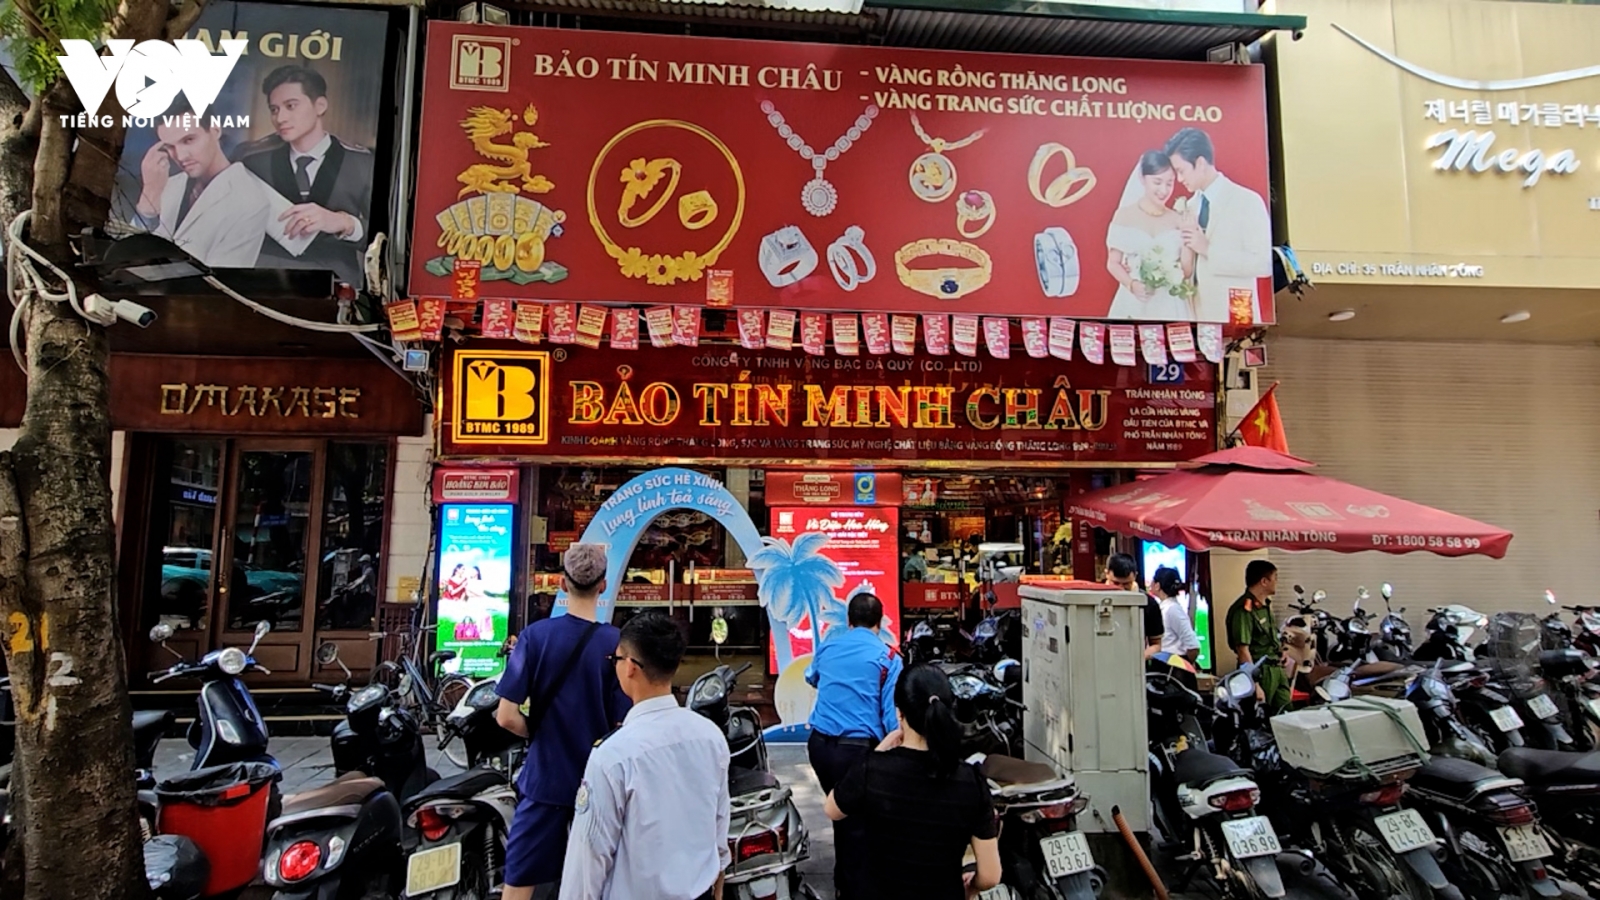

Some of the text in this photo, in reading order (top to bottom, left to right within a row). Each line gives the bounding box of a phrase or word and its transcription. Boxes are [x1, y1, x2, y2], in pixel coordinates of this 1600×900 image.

[259, 29, 343, 60] GIỚI
[534, 50, 843, 92] BẢO TÍN MINH CHÂU
[875, 63, 932, 86] VÀNG
[937, 64, 995, 88] RỒNG
[1000, 68, 1068, 93] THĂNG
[1072, 75, 1126, 95] LONG
[875, 89, 931, 111] VÀNG
[937, 95, 1003, 114] TRANG
[1007, 95, 1047, 116] SỨC
[1051, 98, 1102, 118] CHẤT
[1107, 103, 1175, 124] LƯỢNG
[1179, 105, 1222, 122] CAO
[1426, 129, 1580, 187] Mega
[1311, 262, 1332, 275] ĐỊA
[1363, 263, 1376, 275] 35
[1380, 261, 1413, 276] TRẦN
[1415, 263, 1447, 276] NHÂN
[692, 354, 730, 368] CÔNG
[756, 356, 790, 369] TNHH
[794, 356, 831, 371] VÀNG
[834, 358, 861, 372] BẠC
[866, 357, 883, 370] ĐÁ
[887, 357, 914, 371] QUÝ
[1156, 364, 1180, 381] 29
[161, 383, 361, 418] OMAKASE
[568, 364, 1112, 431] BẢO TÍN MINH CHÂU
[1125, 387, 1206, 400] TRẦN NHÂN TÔNG
[466, 422, 535, 434] BTMC 1989
[561, 436, 583, 446] KINH
[620, 434, 646, 447] VÀNG
[801, 439, 831, 449] TRANG
[832, 437, 849, 449] SỨC
[894, 437, 916, 450] CHẤT
[601, 485, 643, 511] TRANG
[645, 474, 671, 490] SỨC
[674, 472, 691, 485] HÈ
[601, 507, 643, 537] Lung
[637, 492, 666, 514] linh
[697, 493, 735, 517] sáng
[1209, 529, 1337, 542] 29 TRẦN NHÂN TÔNG
[1372, 534, 1480, 548] ĐT: 1800 58 58 99
[49, 651, 83, 686] 2
